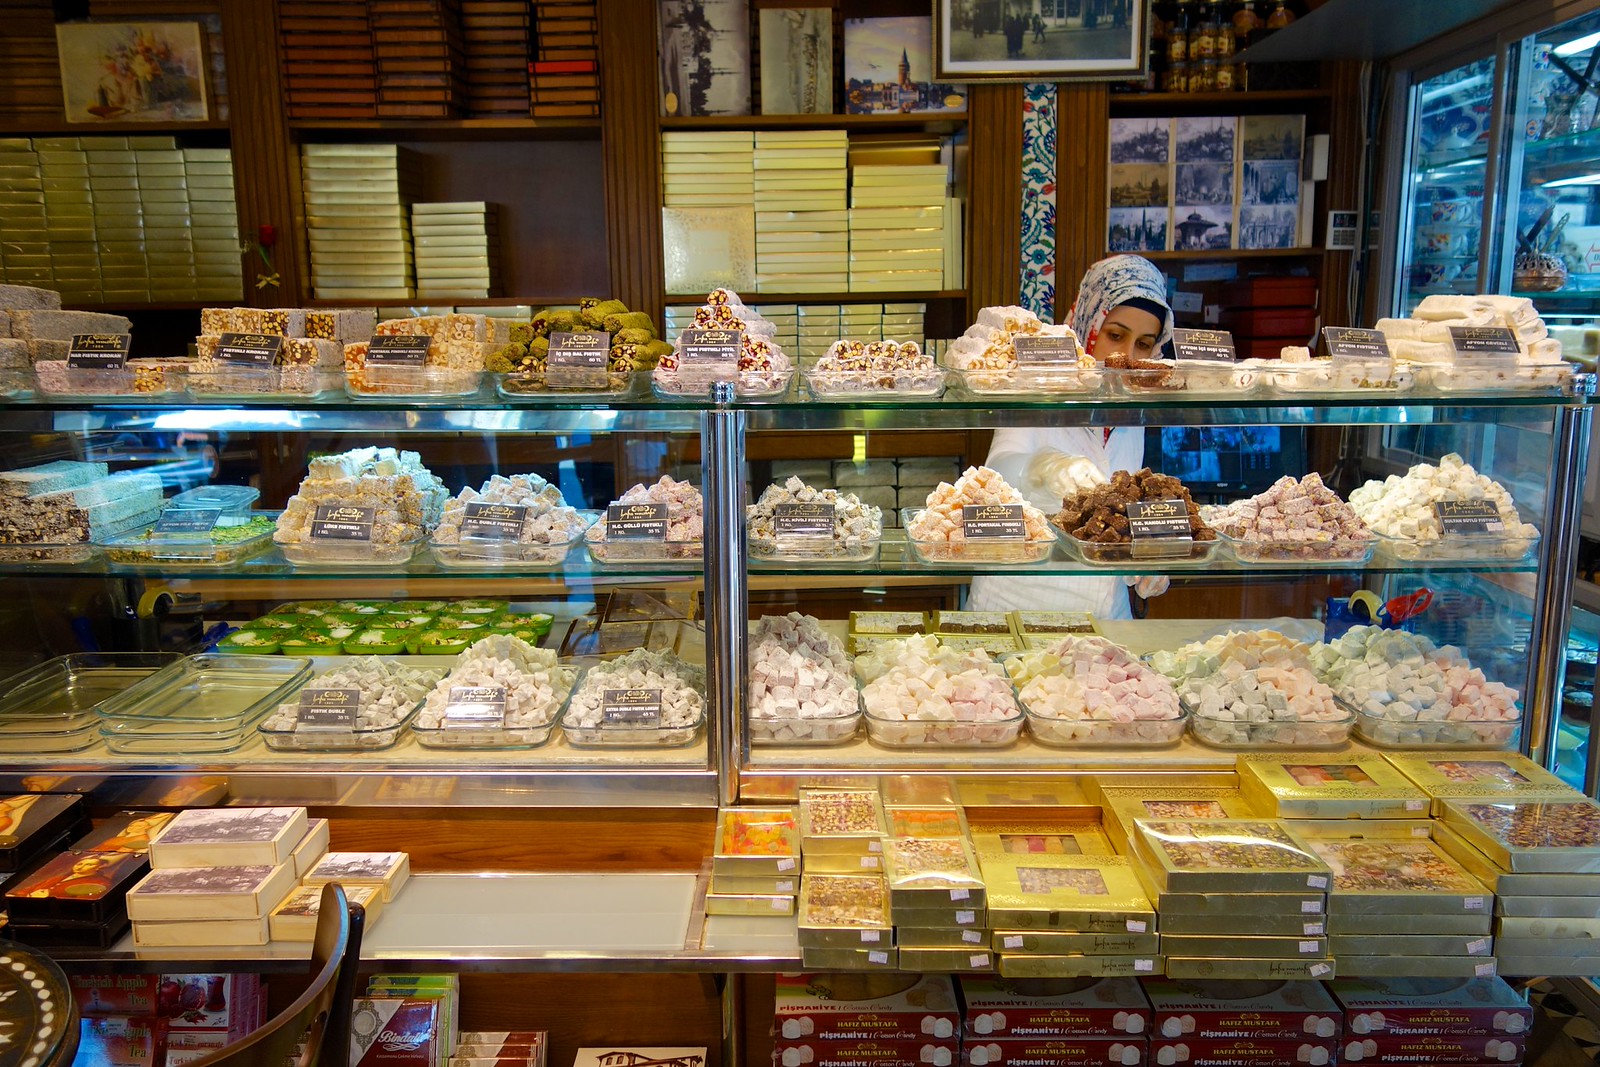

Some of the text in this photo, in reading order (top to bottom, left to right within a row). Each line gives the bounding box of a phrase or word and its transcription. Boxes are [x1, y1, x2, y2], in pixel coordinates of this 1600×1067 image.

[116, 976, 147, 991] Apple
[129, 994, 147, 1005] Tea
[819, 1031, 868, 1039] PİŞMANİYE
[1011, 1027, 1059, 1035] PİŞMANİYE
[1201, 1030, 1249, 1038] PİŞMANİYE
[1390, 1027, 1438, 1035] PİŞMANİYE
[129, 1046, 146, 1058] Tea
[1007, 1058, 1055, 1066] PİŞMANİYE
[1194, 1058, 1243, 1066] PİŞMANİYE
[1382, 1054, 1430, 1062] PİŞMANİYE
